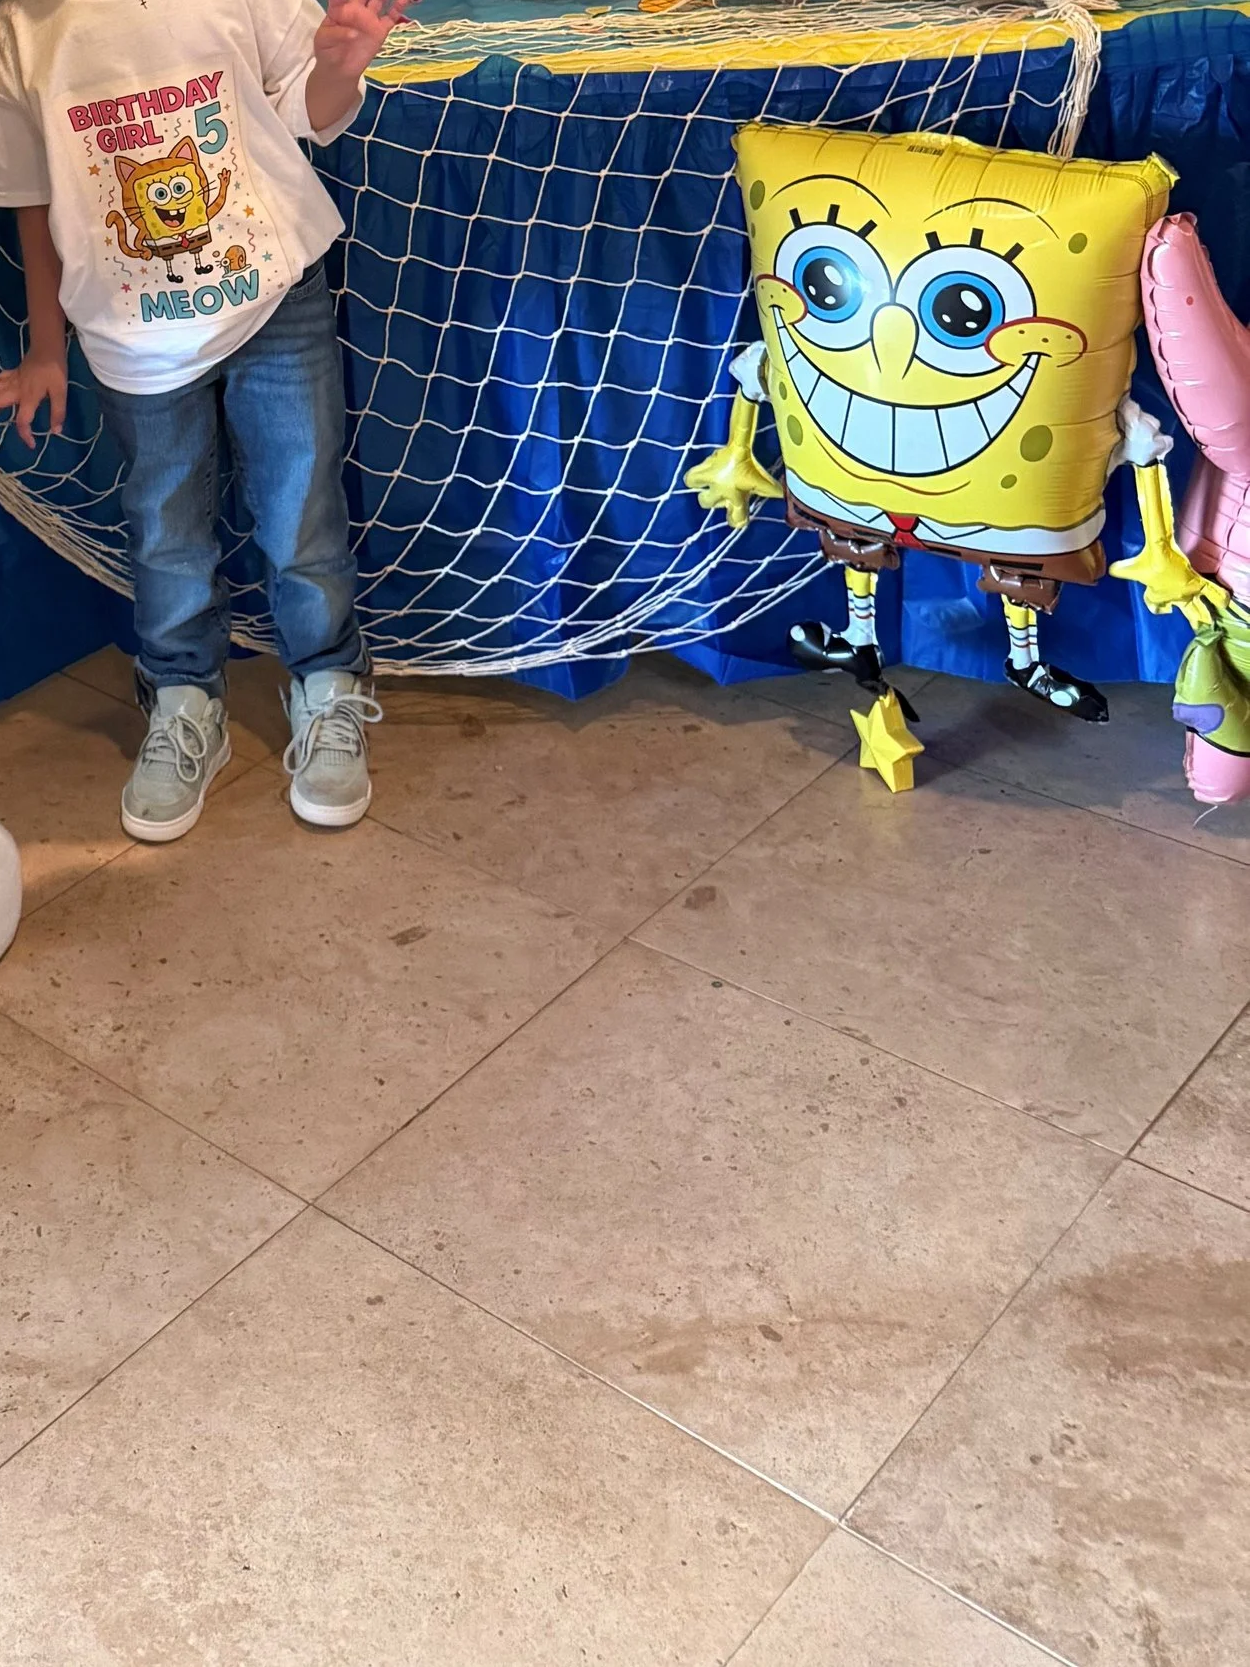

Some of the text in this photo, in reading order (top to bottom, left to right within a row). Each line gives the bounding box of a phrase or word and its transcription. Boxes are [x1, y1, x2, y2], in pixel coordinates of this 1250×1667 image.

[67, 70, 224, 132] BIRTHDAY
[96, 101, 229, 155] GIRL 5
[140, 268, 260, 322] MEOW
